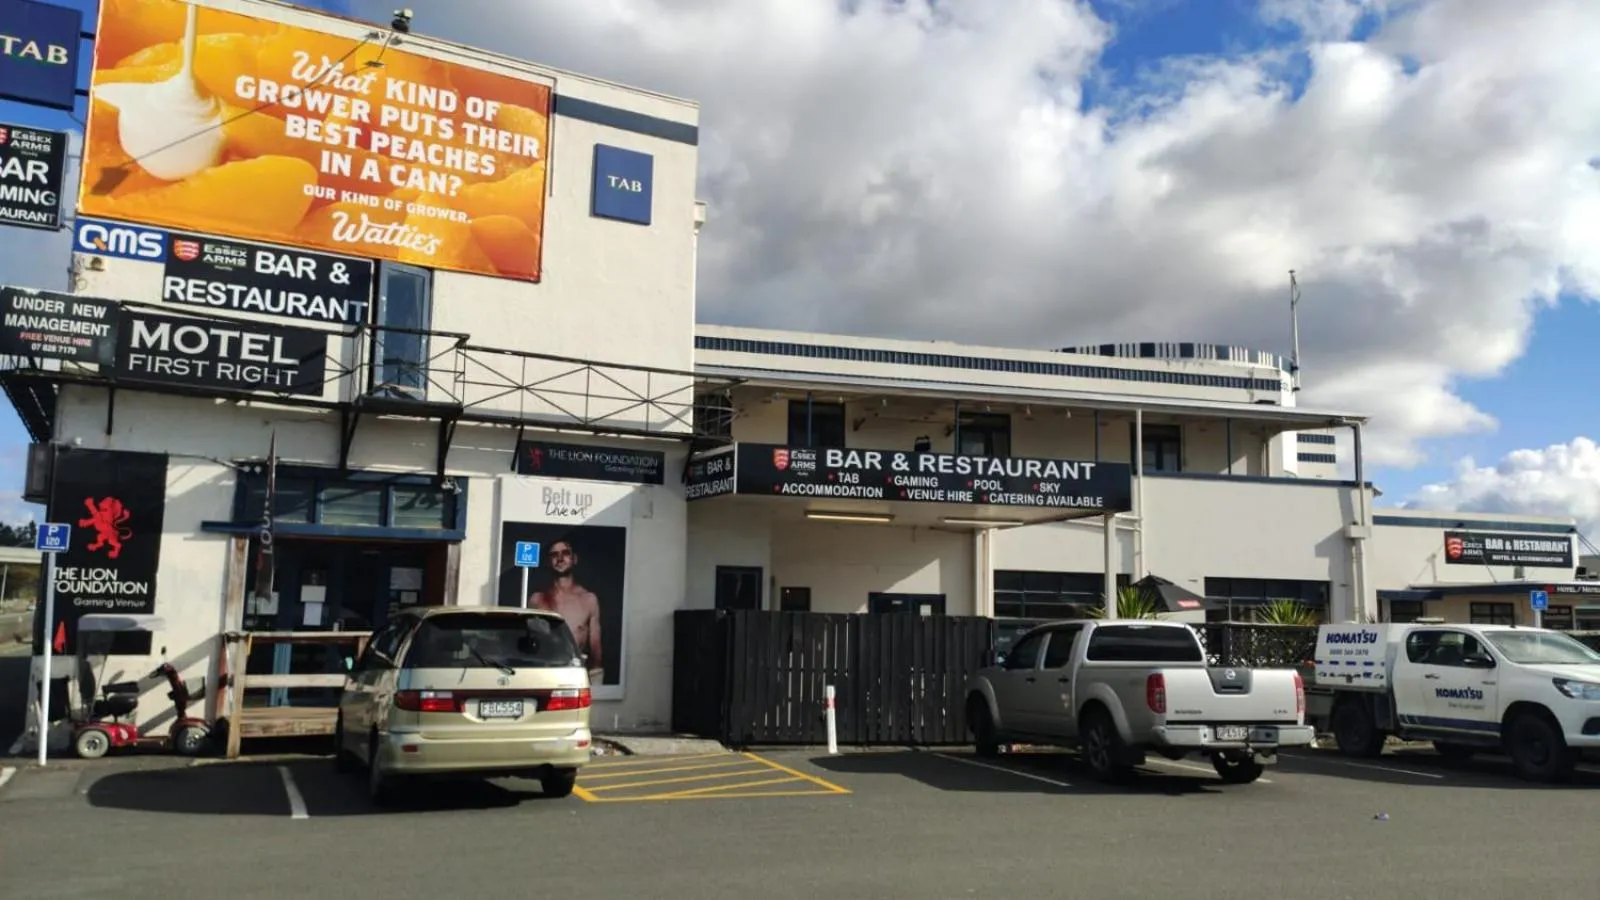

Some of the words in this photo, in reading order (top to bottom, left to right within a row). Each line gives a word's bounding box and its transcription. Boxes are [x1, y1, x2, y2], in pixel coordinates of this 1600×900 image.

[0, 34, 69, 65] TAB
[291, 51, 377, 95] What
[385, 77, 457, 112] KIND
[465, 96, 500, 122] OF
[235, 75, 370, 123] GROWER
[380, 104, 454, 140] PUTS
[461, 122, 540, 159] THEIR
[10, 139, 51, 152] ARMS
[285, 114, 362, 149] BEST
[370, 131, 496, 176] PEACHES
[0, 157, 48, 184] AR
[320, 149, 352, 177] IN
[360, 158, 381, 183] A
[390, 164, 463, 197] CAN?
[607, 175, 642, 193] TAB
[0, 185, 56, 206] MING
[303, 183, 336, 200] OUR
[341, 190, 380, 208] KIND
[384, 198, 403, 212] OF
[406, 202, 473, 224] GROWER.
[0, 207, 55, 224] AURANT
[331, 211, 443, 256] Wattie's
[202, 254, 247, 267] ARMS
[254, 250, 317, 281] BAR
[329, 262, 350, 285] &
[12, 296, 65, 314] UNDER
[72, 303, 107, 319] NEW
[163, 275, 368, 323] RESTAURANT
[4, 313, 111, 337] MANAGEMENT
[19, 331, 42, 342] FREE
[43, 333, 71, 345] VENUE
[31, 343, 41, 351] 07
[130, 319, 299, 365] MOTEL
[128, 353, 210, 378] FIRST
[216, 362, 299, 387] RIGHT
[548, 449, 566, 460] THE
[568, 451, 593, 463] LION
[595, 452, 658, 467] FOUNDATION
[706, 458, 723, 475] BAR
[724, 457, 731, 471] &
[790, 461, 816, 470] ARMS
[825, 449, 882, 471] BAR
[891, 452, 910, 471] &
[919, 453, 1096, 480] RESTAURANT
[686, 477, 734, 498] RESTAURANT
[837, 472, 859, 483] TAB
[894, 475, 938, 487] GAMING
[973, 479, 1003, 491] POOL
[1039, 482, 1061, 493] SKY
[542, 487, 570, 505] Belt
[576, 492, 593, 510] up
[781, 483, 883, 498] ACCOMMODATION
[907, 489, 944, 501] VENUE
[947, 491, 973, 502] HIRE
[989, 493, 1044, 506] CATERING
[1046, 495, 1103, 507] AVAILABLE
[545, 501, 569, 516] Live
[45, 536, 61, 546] 120
[48, 526, 59, 536] P
[1485, 538, 1504, 551] BAR
[1505, 541, 1512, 550] &
[1513, 539, 1569, 553] RESTAURANT
[52, 567, 78, 580] THE
[81, 567, 118, 581] LION
[73, 597, 114, 608] Gaming
[116, 598, 146, 607] Venue
[1326, 629, 1378, 644] KOMATSU
[1436, 686, 1483, 700] KOMATSU
